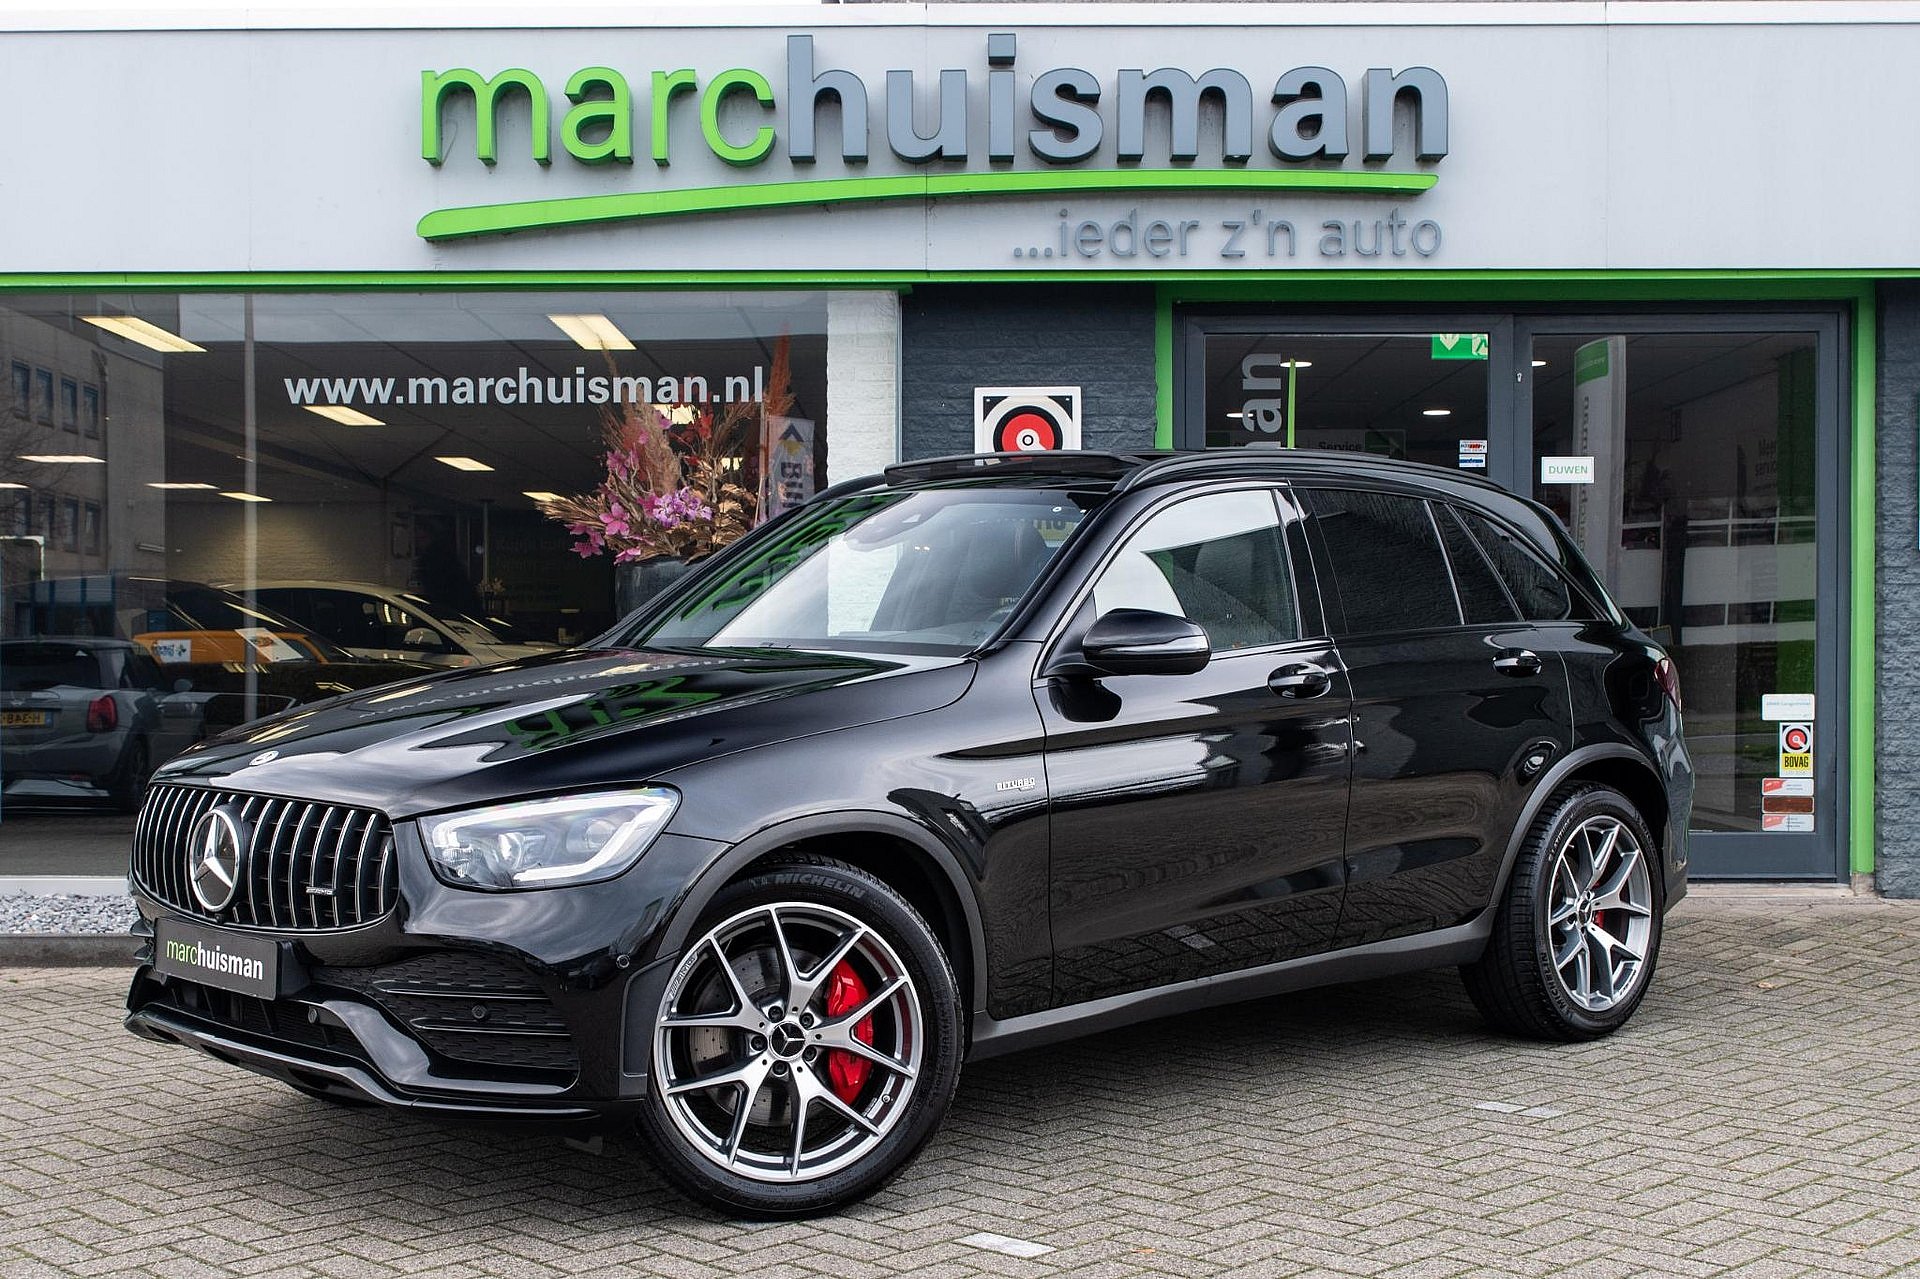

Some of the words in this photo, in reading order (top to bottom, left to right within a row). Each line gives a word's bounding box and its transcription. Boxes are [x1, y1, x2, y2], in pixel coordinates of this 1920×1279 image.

[419, 33, 1449, 168] marchuisman
[1221, 209, 1296, 258] z'n
[1322, 208, 1443, 258] auto
[284, 366, 765, 406] www.marchuisman.nl
[1548, 464, 1589, 476] DUWEN
[1784, 756, 1809, 768] BOVAG
[773, 873, 866, 898] MICHELIN
[166, 939, 263, 980] marchuisman
